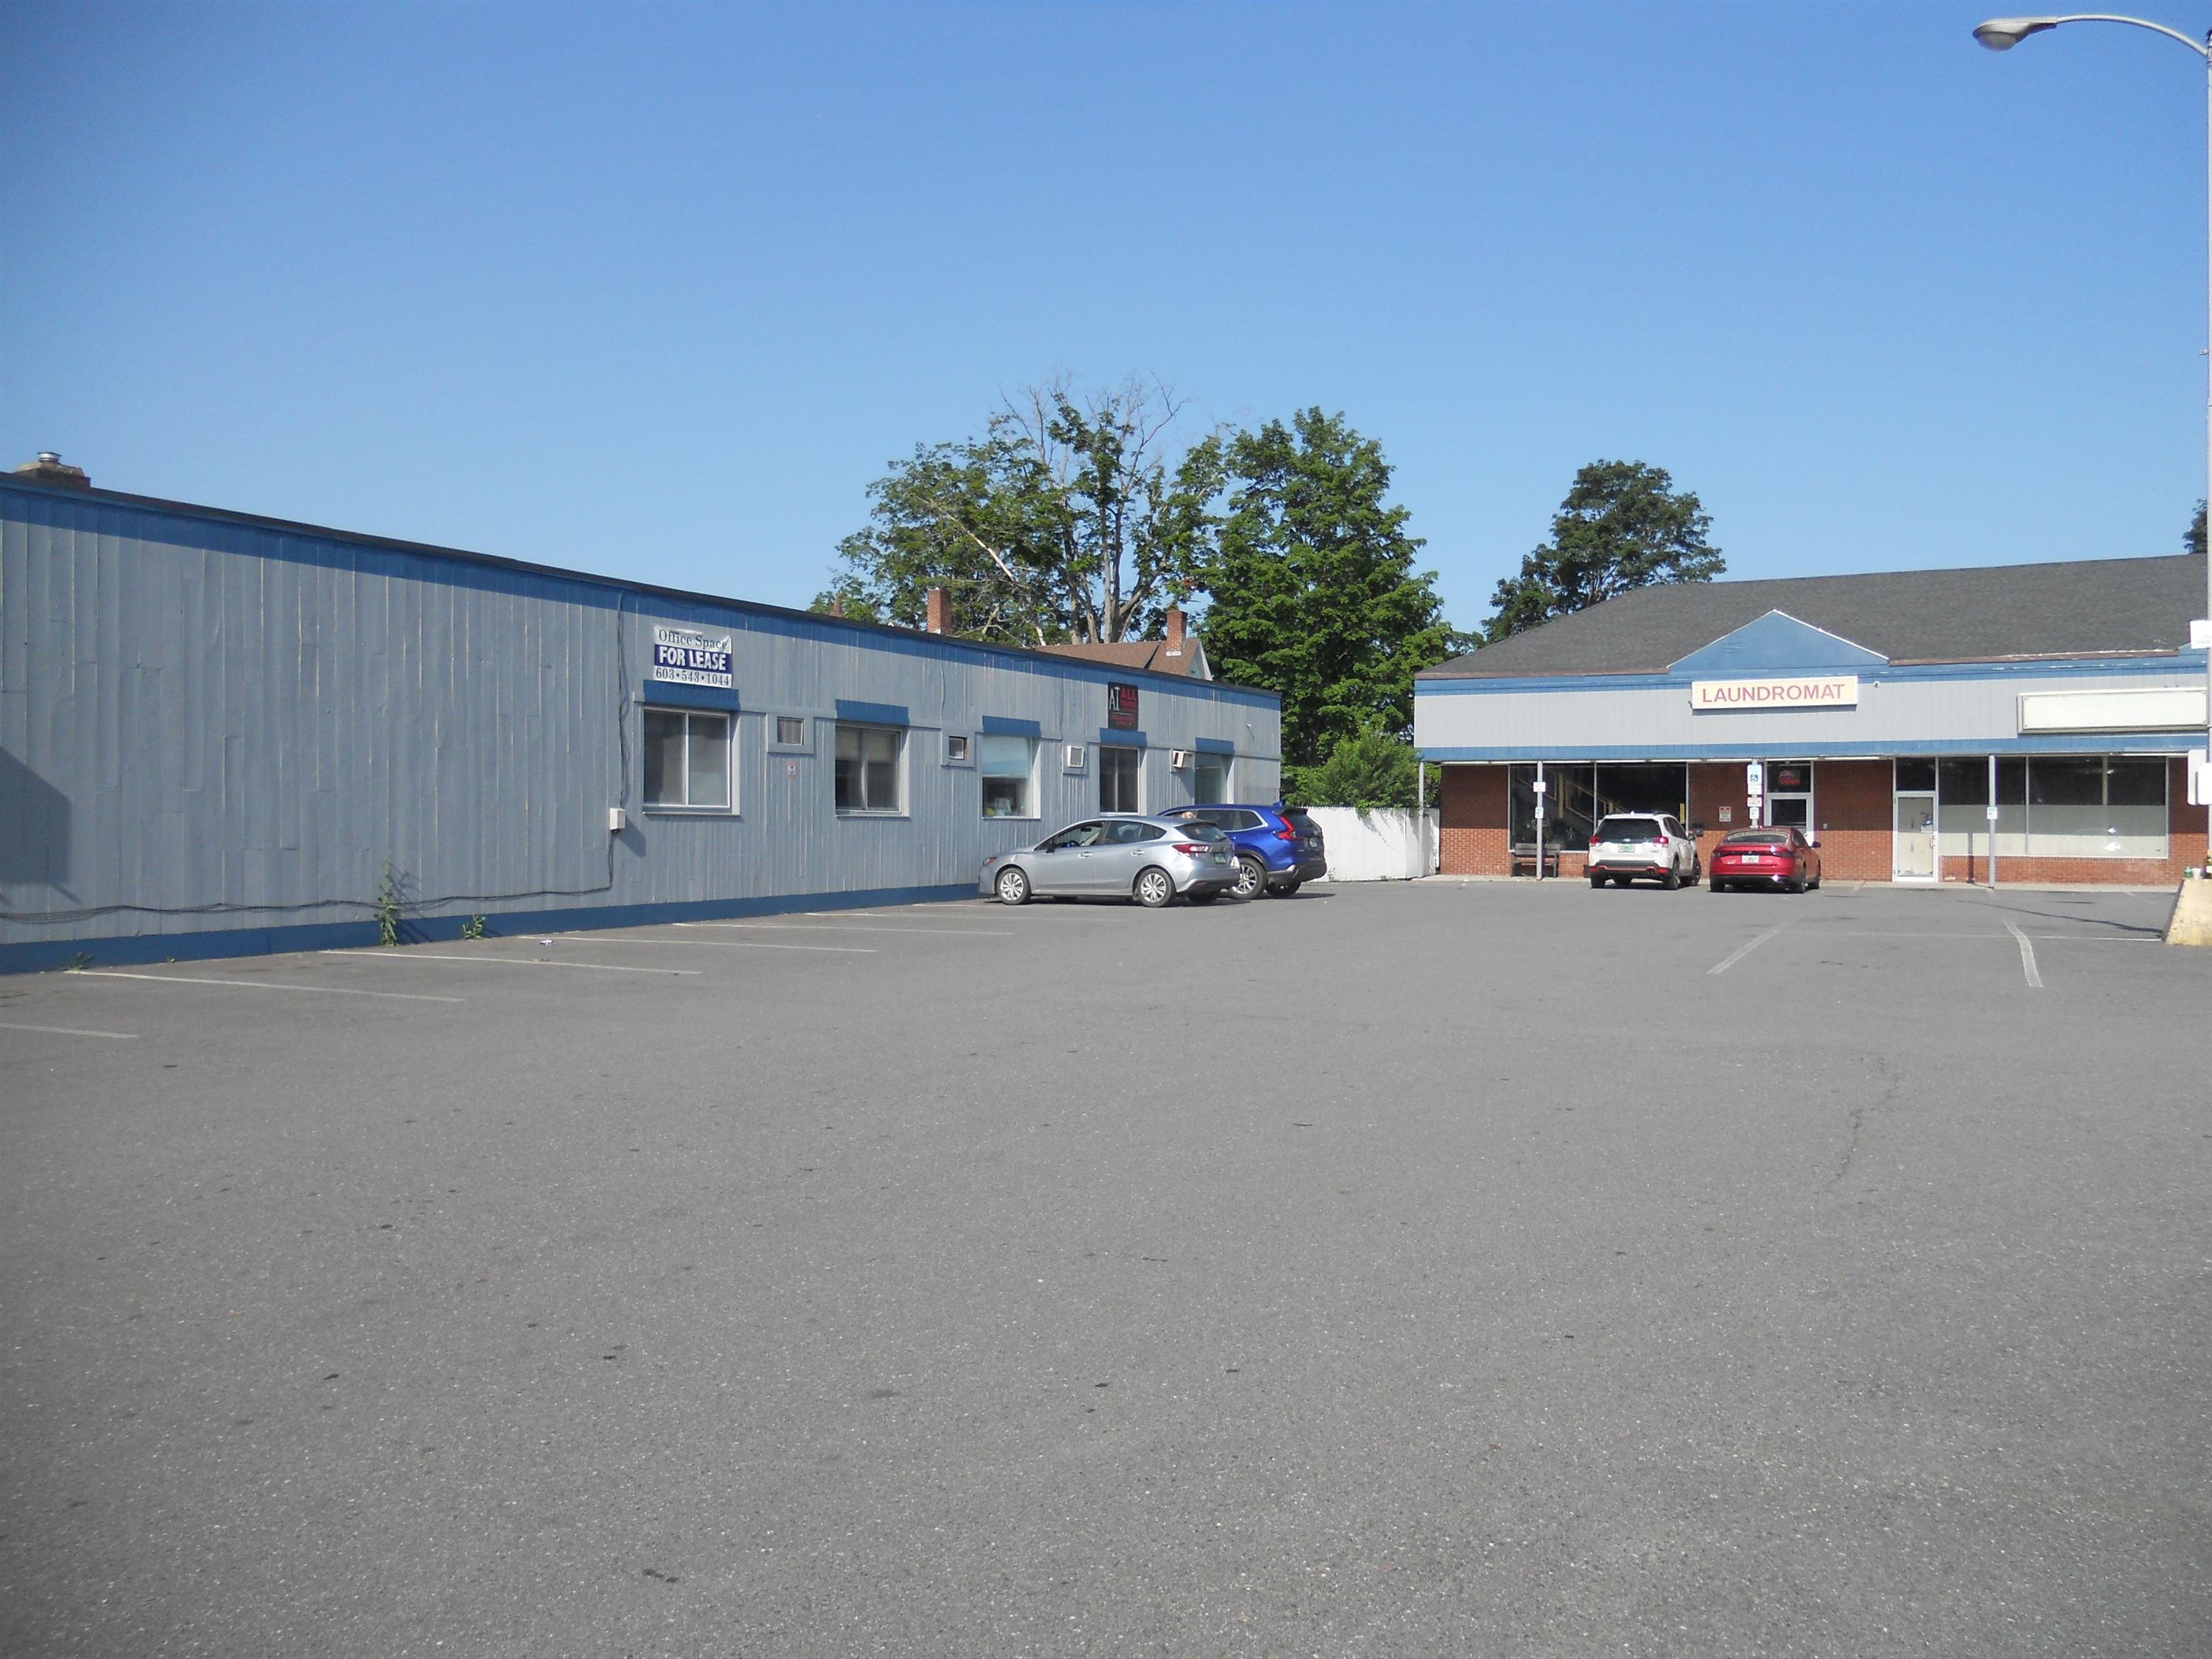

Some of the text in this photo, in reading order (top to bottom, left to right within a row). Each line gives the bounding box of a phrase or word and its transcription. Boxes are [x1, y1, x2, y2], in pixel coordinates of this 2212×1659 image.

[659, 629, 727, 649] Office Space
[660, 646, 726, 670] FOR LEASE
[1702, 683, 1845, 703] LAUNDROMAT
